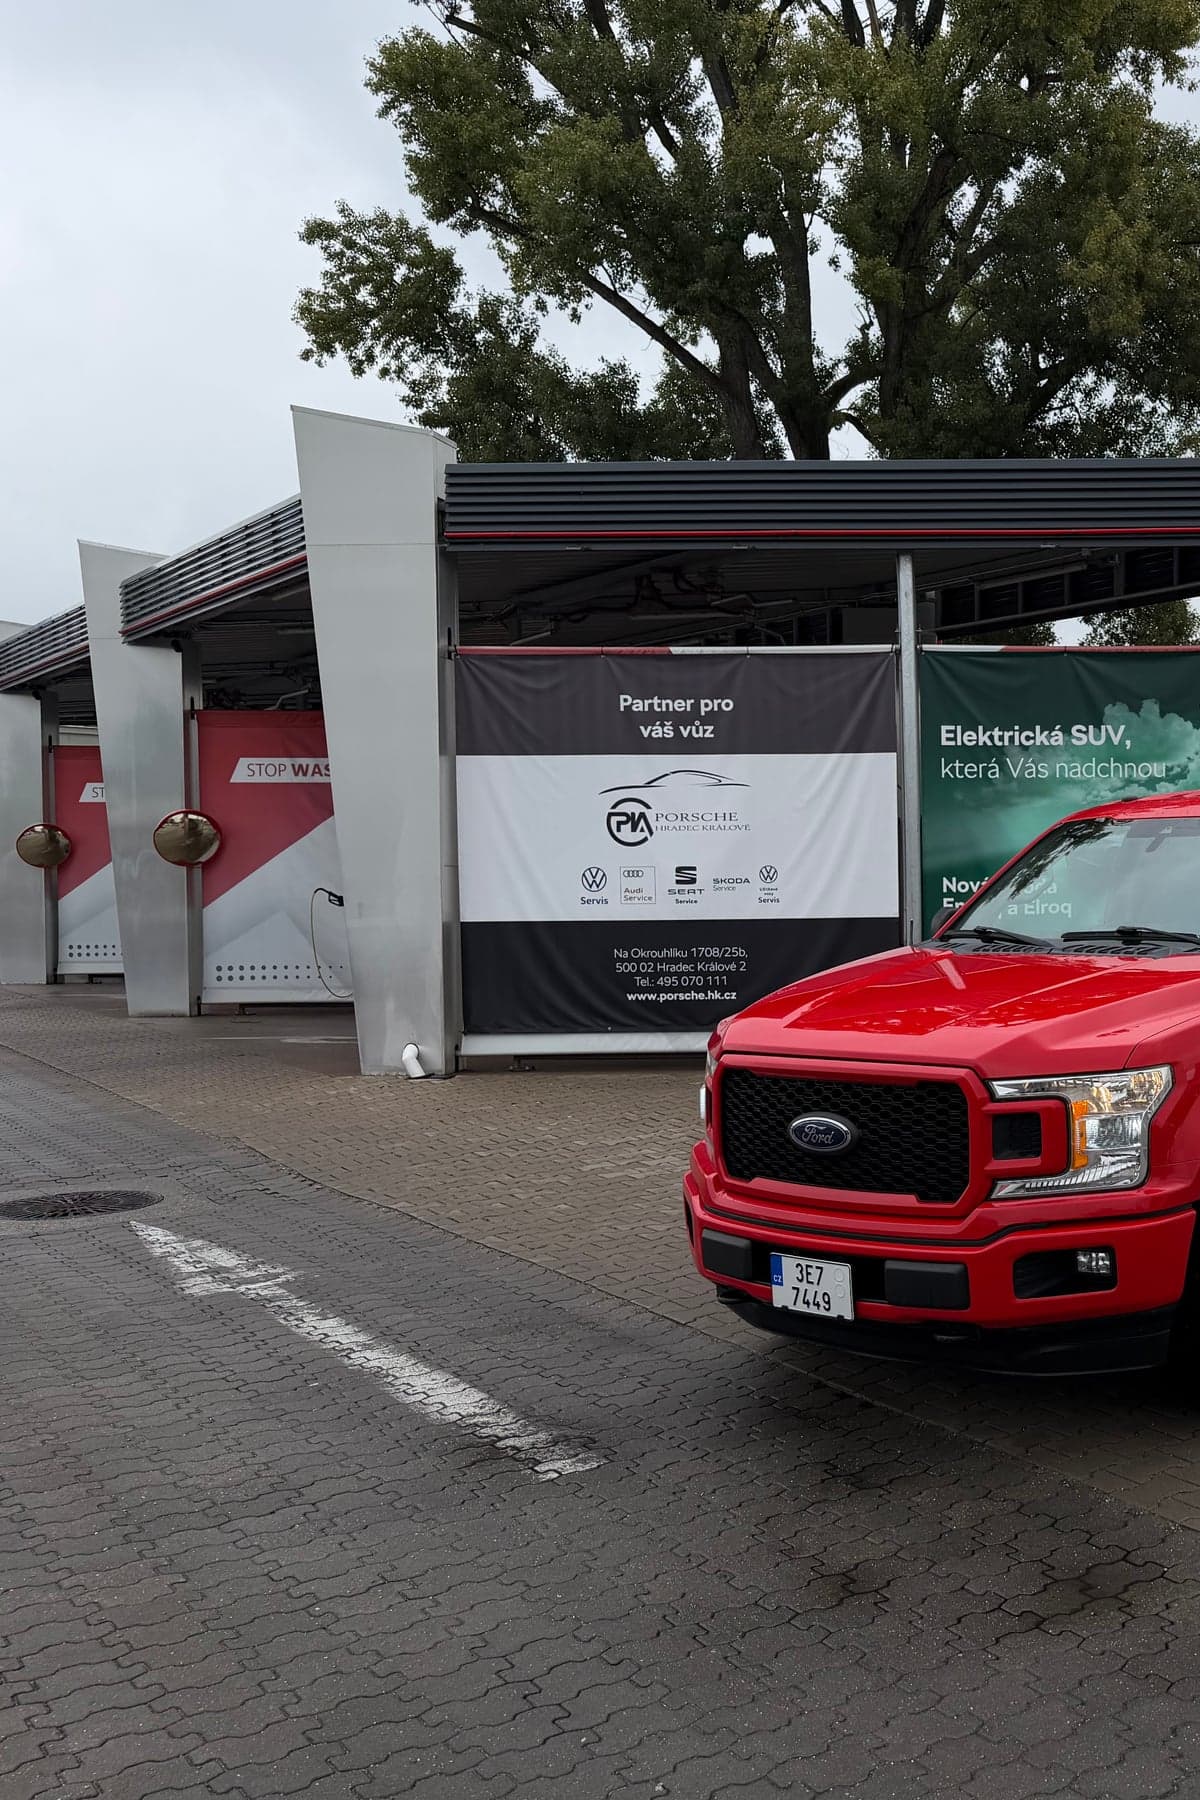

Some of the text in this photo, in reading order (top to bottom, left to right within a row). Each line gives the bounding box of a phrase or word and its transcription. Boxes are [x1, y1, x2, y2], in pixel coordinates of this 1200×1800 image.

[619, 694, 734, 716] Partner pro
[640, 720, 714, 738] váš vůz
[940, 725, 1131, 749] Elektrická SUV,
[247, 763, 287, 777] STOP
[941, 758, 1166, 779] která Vás nadchnou
[655, 812, 739, 822] PORSCHE
[655, 822, 751, 832] HRADEC KRÁLOVÉ
[623, 894, 653, 902] Service
[667, 888, 705, 896] SEAT
[580, 896, 609, 905] Servis
[1007, 900, 1072, 918] a Elroq
[614, 946, 748, 959] Na Okrouhlíku 1708/25b,
[615, 961, 747, 973] 500 02 Hradec Králové 2
[634, 976, 727, 987] Tel.: 495 070 111
[626, 990, 737, 1003] www.porsche.hk.cz
[802, 1124, 834, 1144] Ford
[773, 1275, 782, 1283] CZ
[795, 1263, 824, 1286] 3E7
[791, 1286, 831, 1311] 7449
